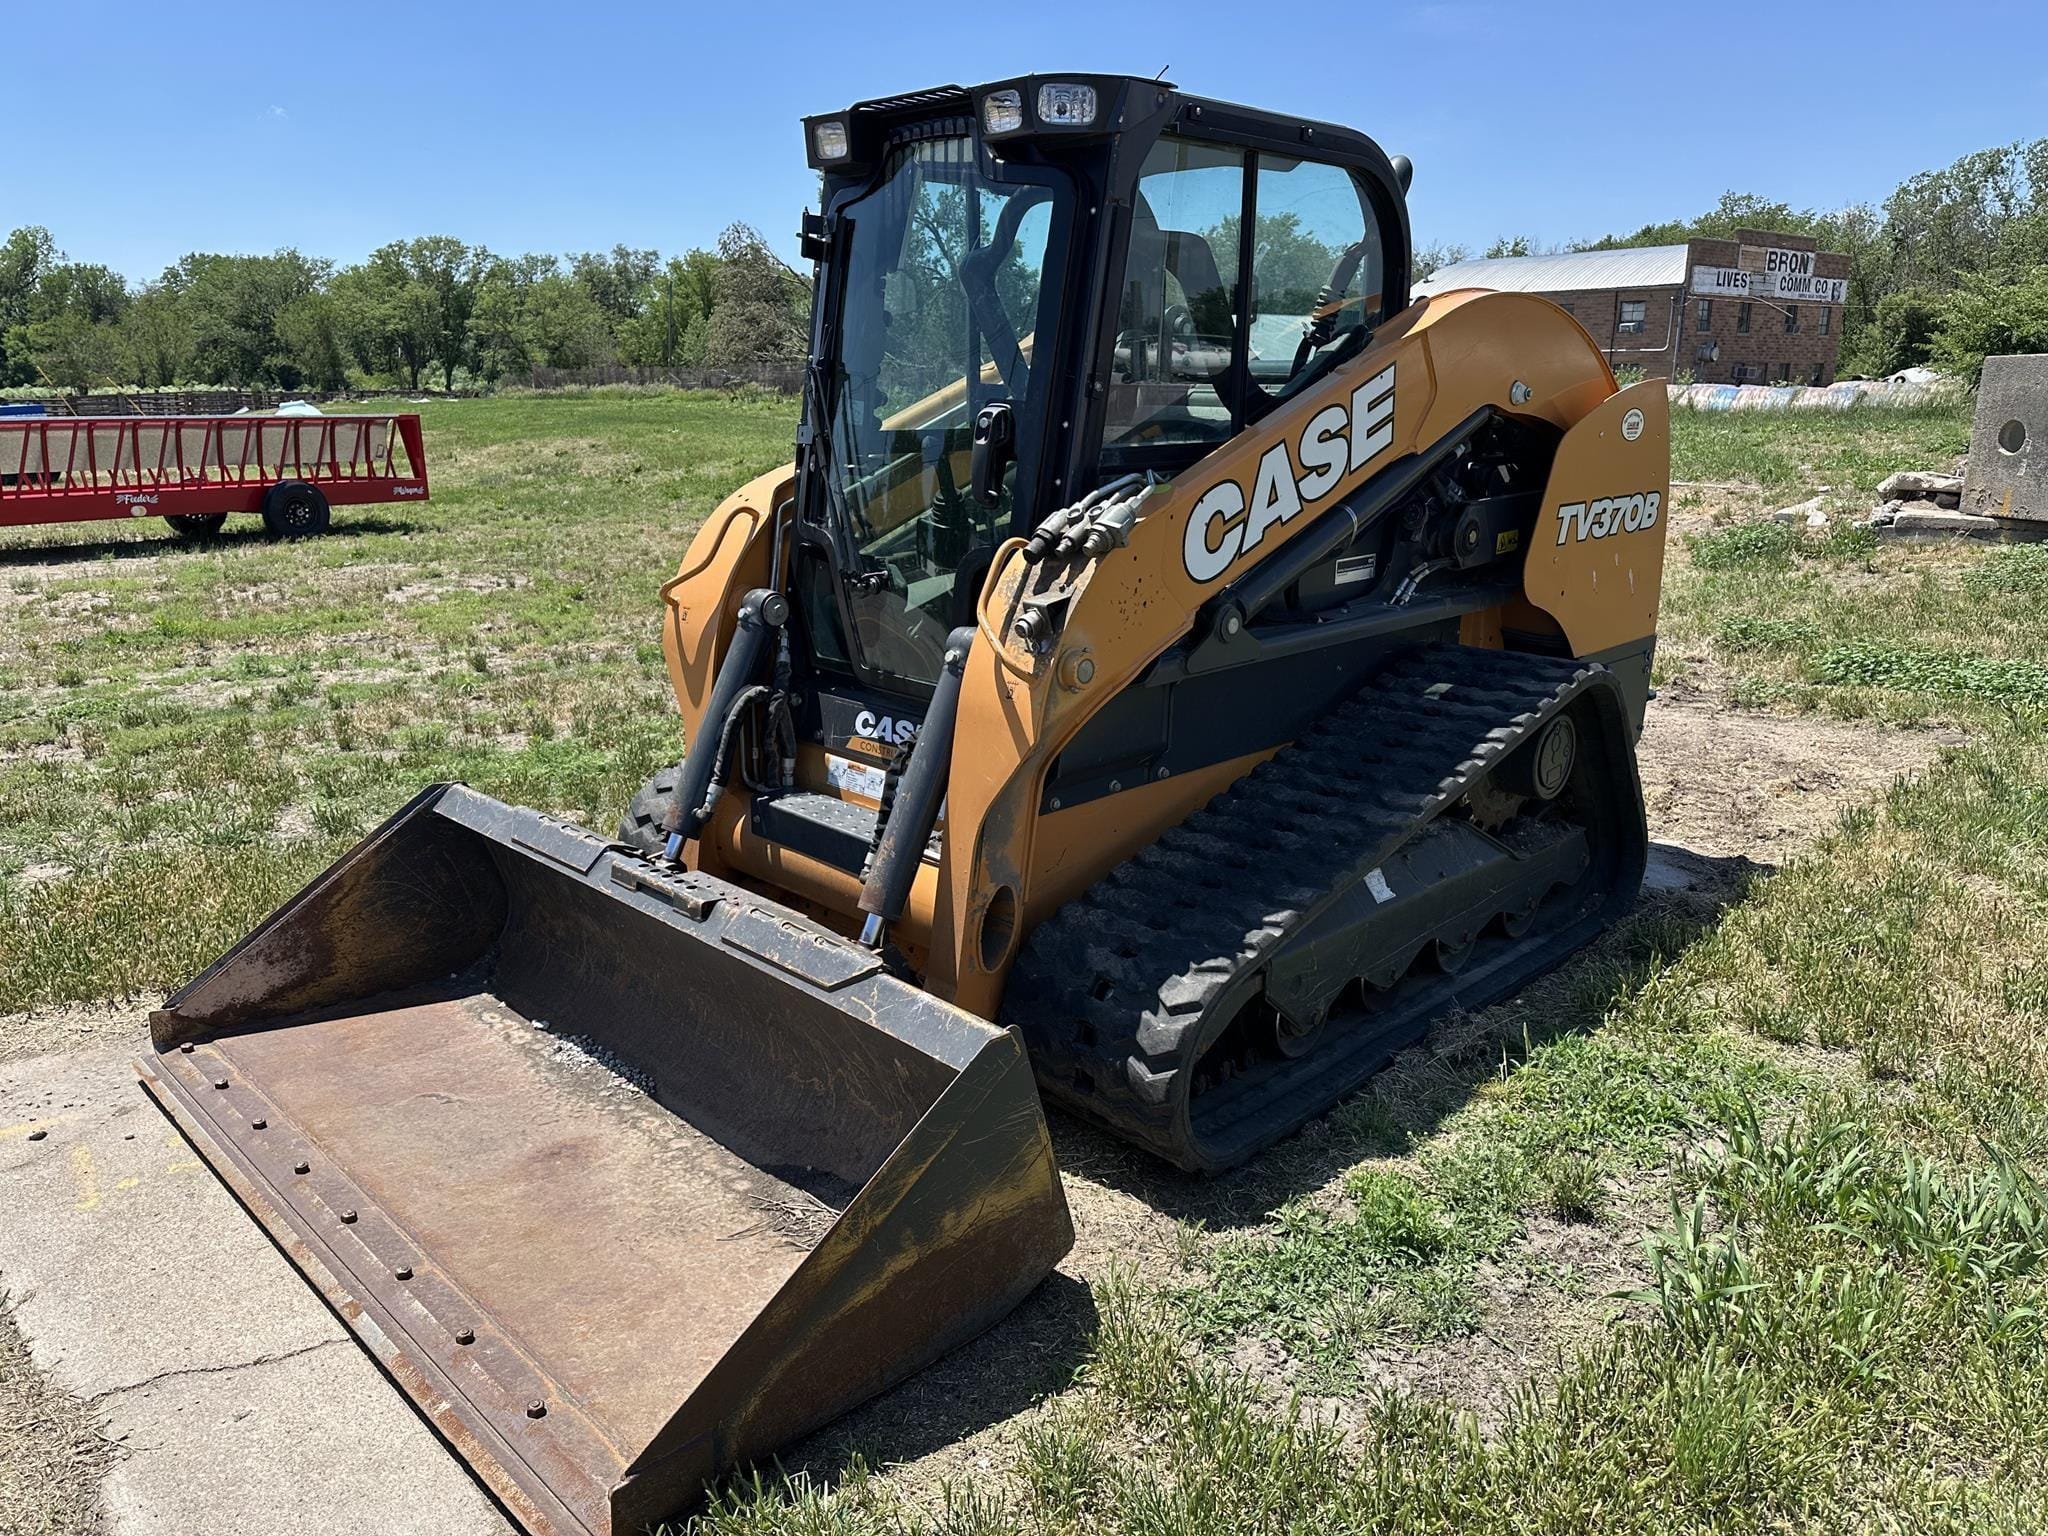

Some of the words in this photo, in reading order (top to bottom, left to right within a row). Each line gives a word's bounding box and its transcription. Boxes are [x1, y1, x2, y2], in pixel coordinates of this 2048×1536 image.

[1766, 251, 1810, 275] BRON
[1716, 270, 1751, 289] LIVES
[1780, 276, 1811, 293] COMM
[1815, 280, 1828, 294] CO
[1183, 361, 1397, 584] CASE
[1556, 491, 1662, 546] TV370B
[855, 710, 922, 745] CAS
